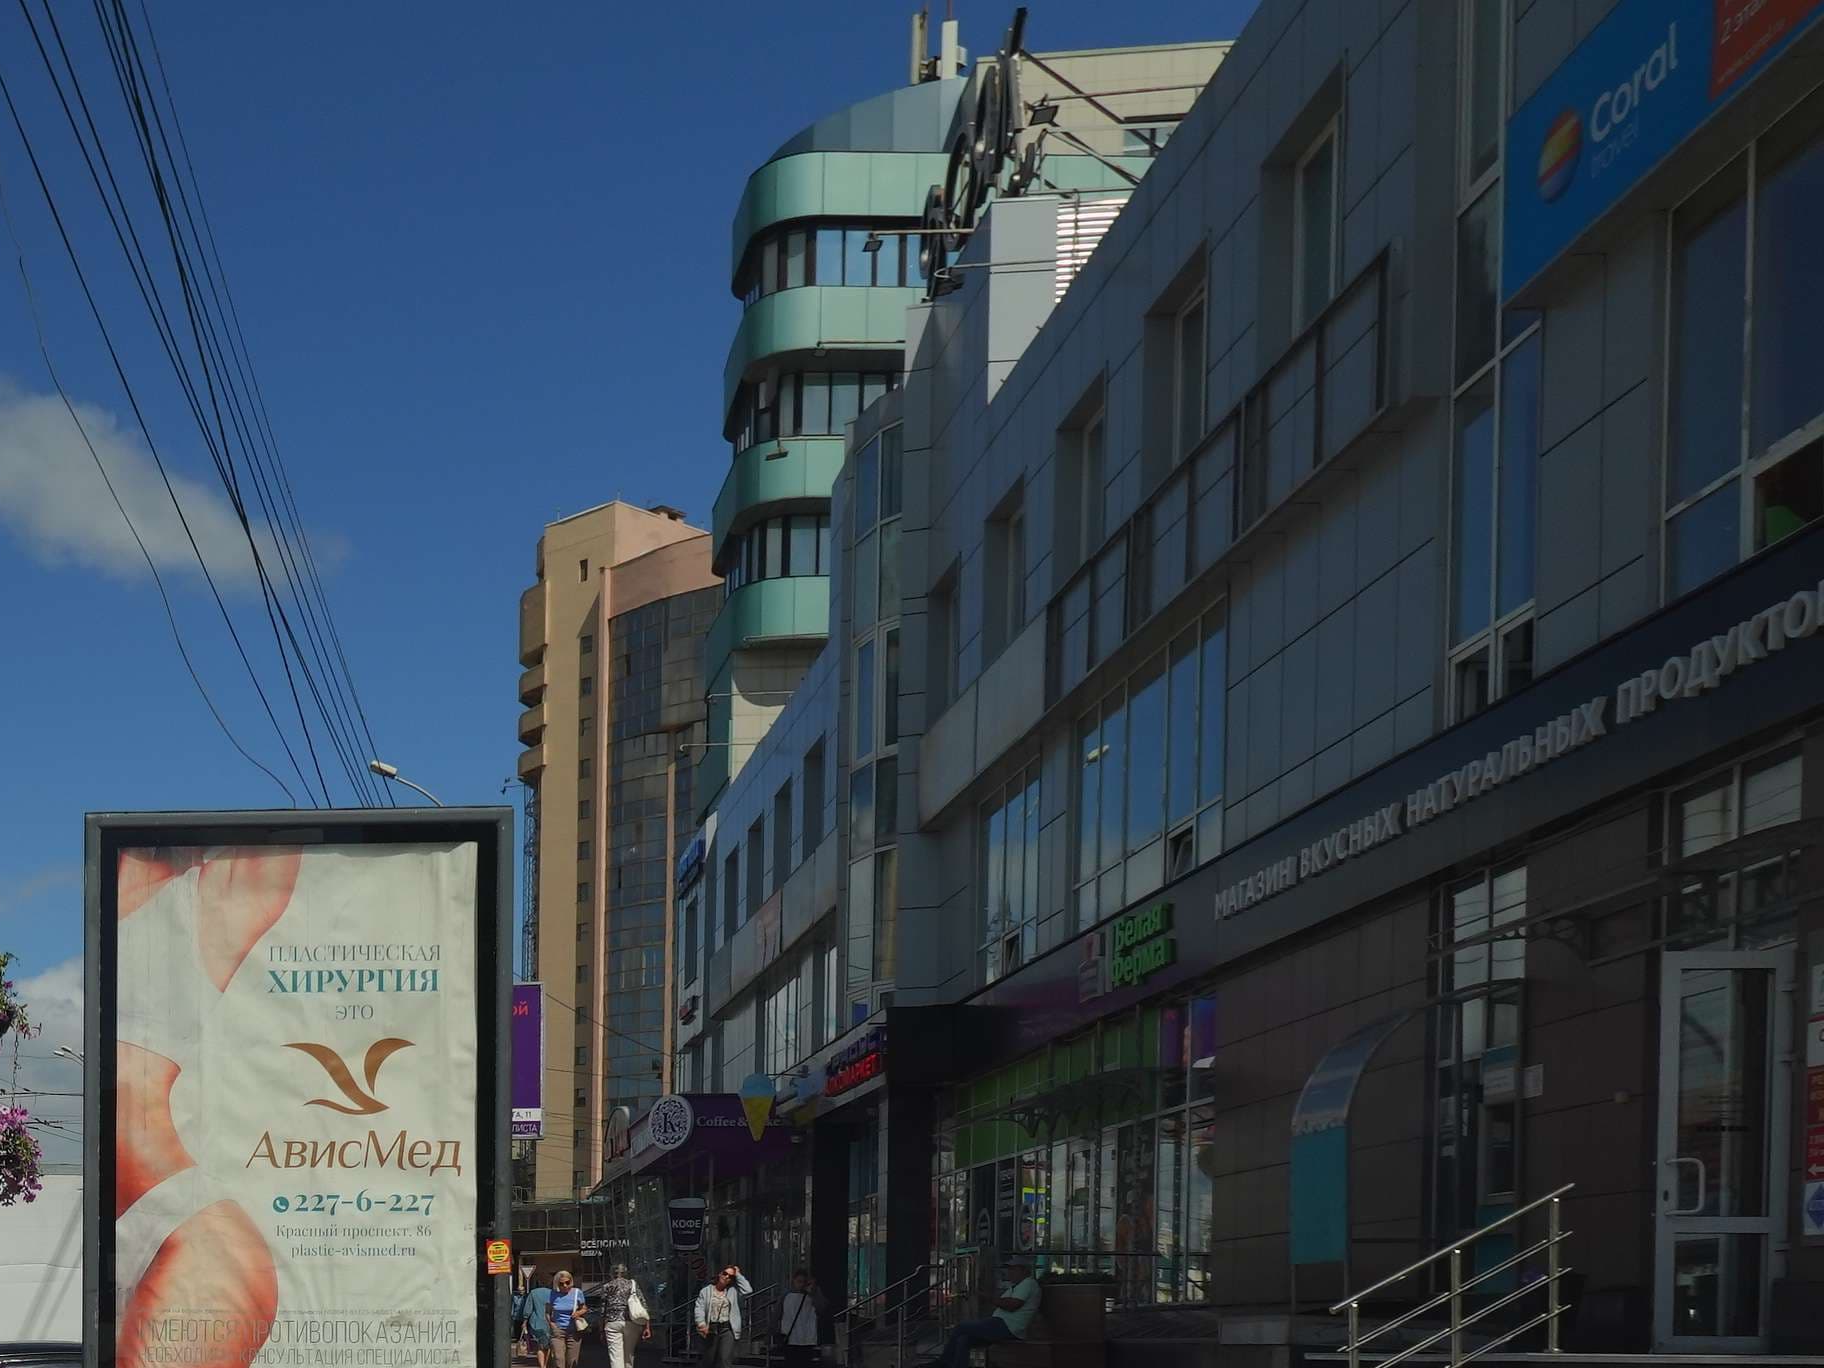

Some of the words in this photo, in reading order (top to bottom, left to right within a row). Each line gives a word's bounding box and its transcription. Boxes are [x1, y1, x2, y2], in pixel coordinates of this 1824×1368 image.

[1591, 20, 1679, 143] Coral
[1214, 856, 1298, 921] МАГАЗИН
[1300, 802, 1404, 878] ВКУСНЫХ
[1406, 696, 1609, 828] НАТУРАЛЬНЫХ
[1615, 578, 1824, 724] ПРОДУКТО
[1113, 901, 1172, 953] Белая
[269, 944, 441, 962] ПЛАСТИЧЕСКАЯ
[267, 968, 439, 993] ХИРУРГИЯ
[335, 1004, 374, 1021] ЭТО
[696, 1115, 736, 1128] Coffee
[245, 1130, 461, 1177] АвисМед
[294, 1188, 435, 1216] 227-6-227
[276, 1223, 338, 1239] Красный
[416, 1224, 432, 1237] 86
[671, 1219, 702, 1229] КОФЕ
[291, 1243, 416, 1259] plastic-avismed.ru
[357, 1348, 461, 1367] СПЕЦИАЛИСТА
